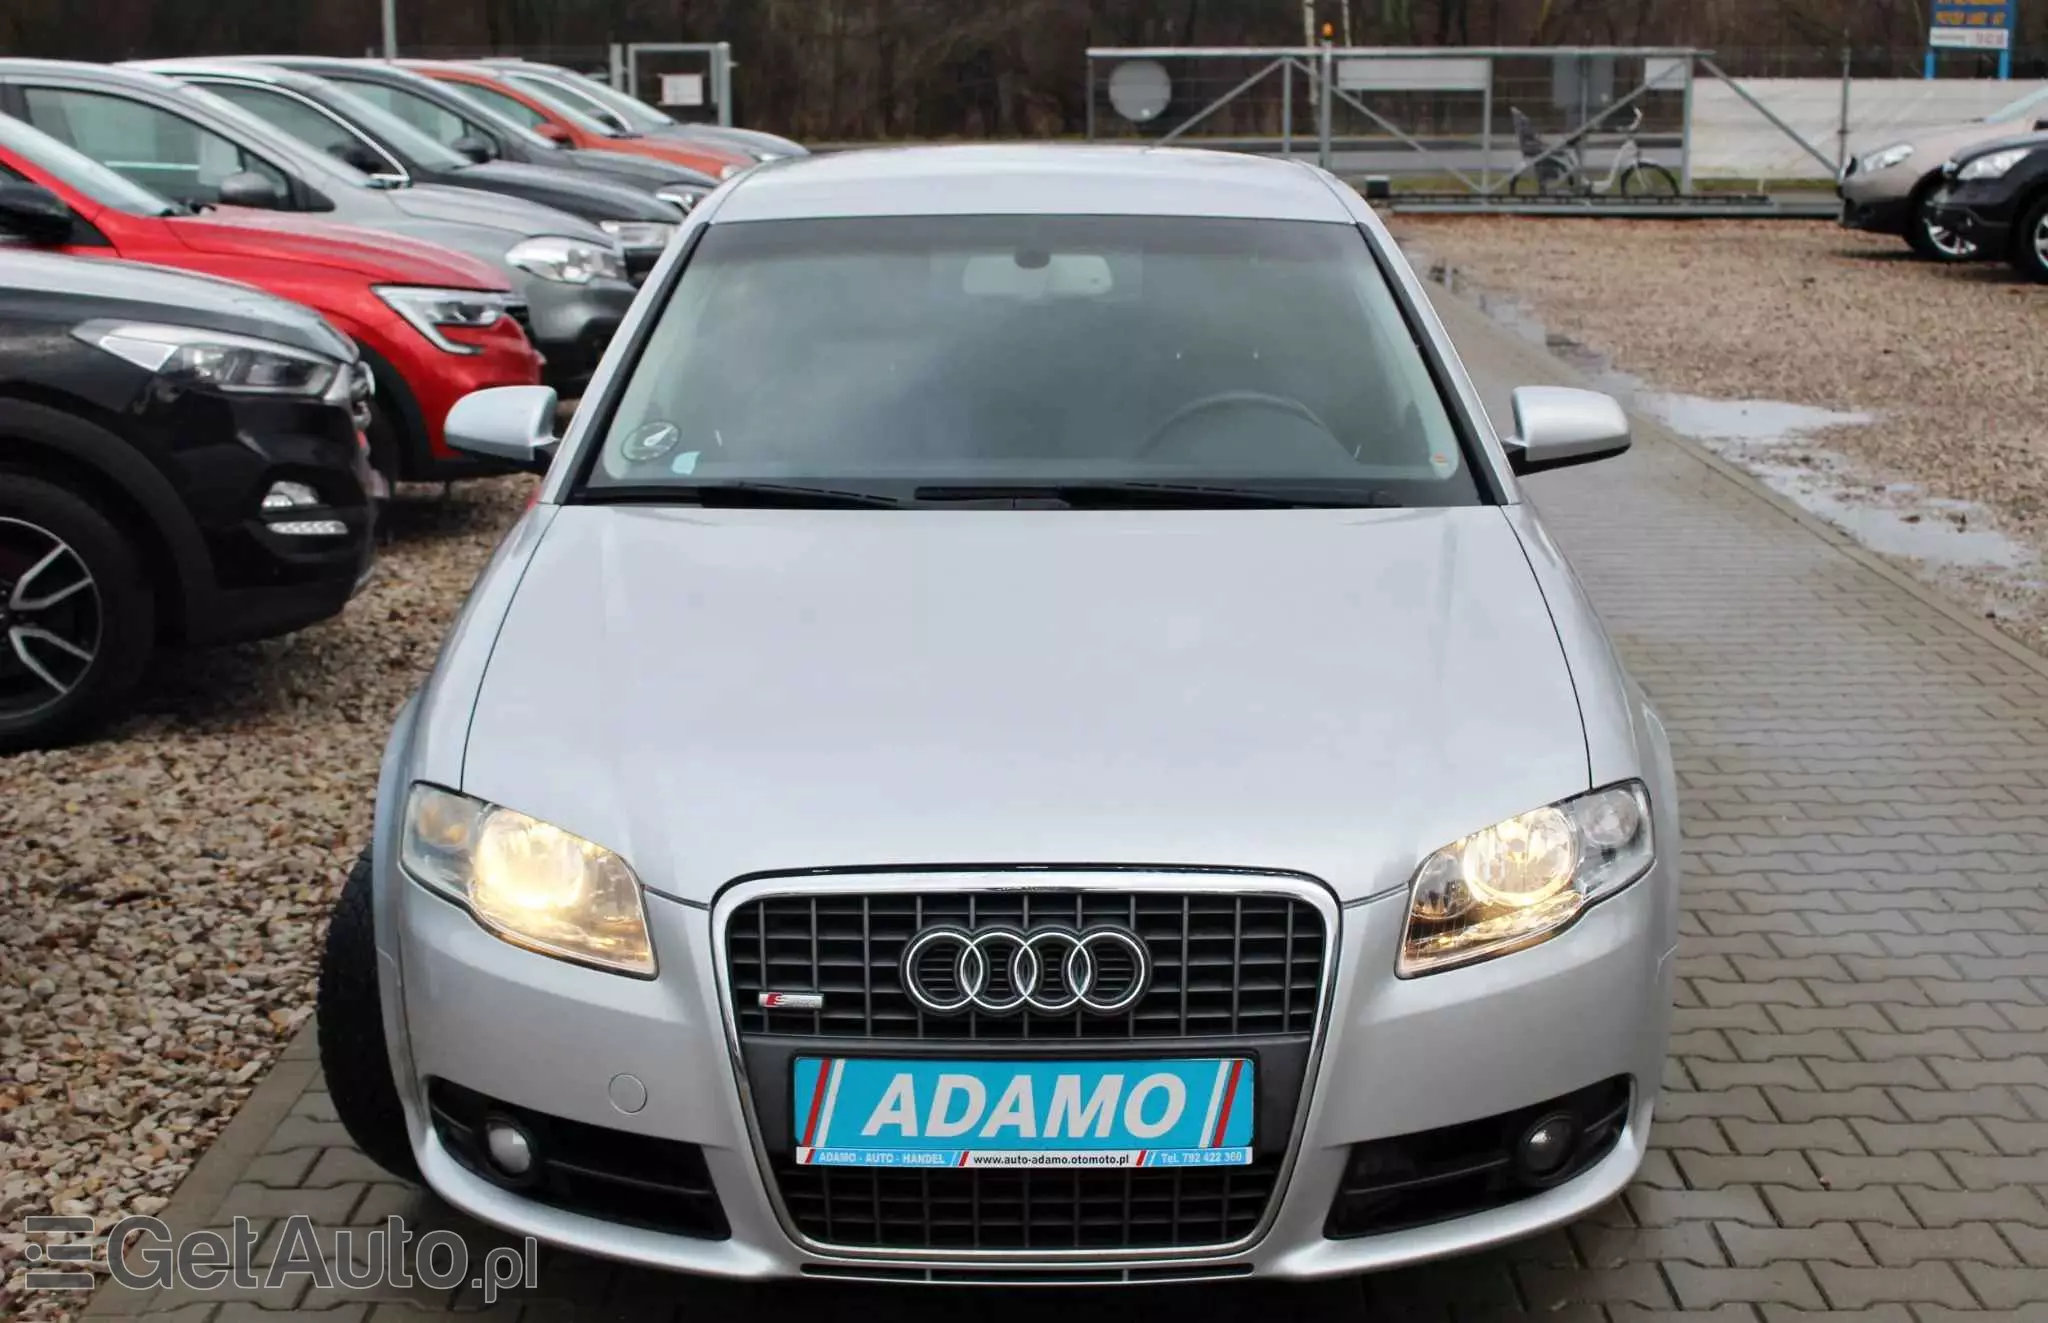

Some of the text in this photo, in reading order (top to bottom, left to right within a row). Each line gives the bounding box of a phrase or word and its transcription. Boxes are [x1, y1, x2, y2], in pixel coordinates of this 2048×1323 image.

[861, 1074, 1187, 1138] ADAMO
[819, 1152, 857, 1163] ADAMO
[865, 1153, 893, 1164] AUTO
[903, 1154, 946, 1165] HANDEL
[974, 1154, 1129, 1166] www.auto-adamo.otomoto.pl
[1182, 1152, 1200, 1163] 792
[1203, 1151, 1221, 1162] 422
